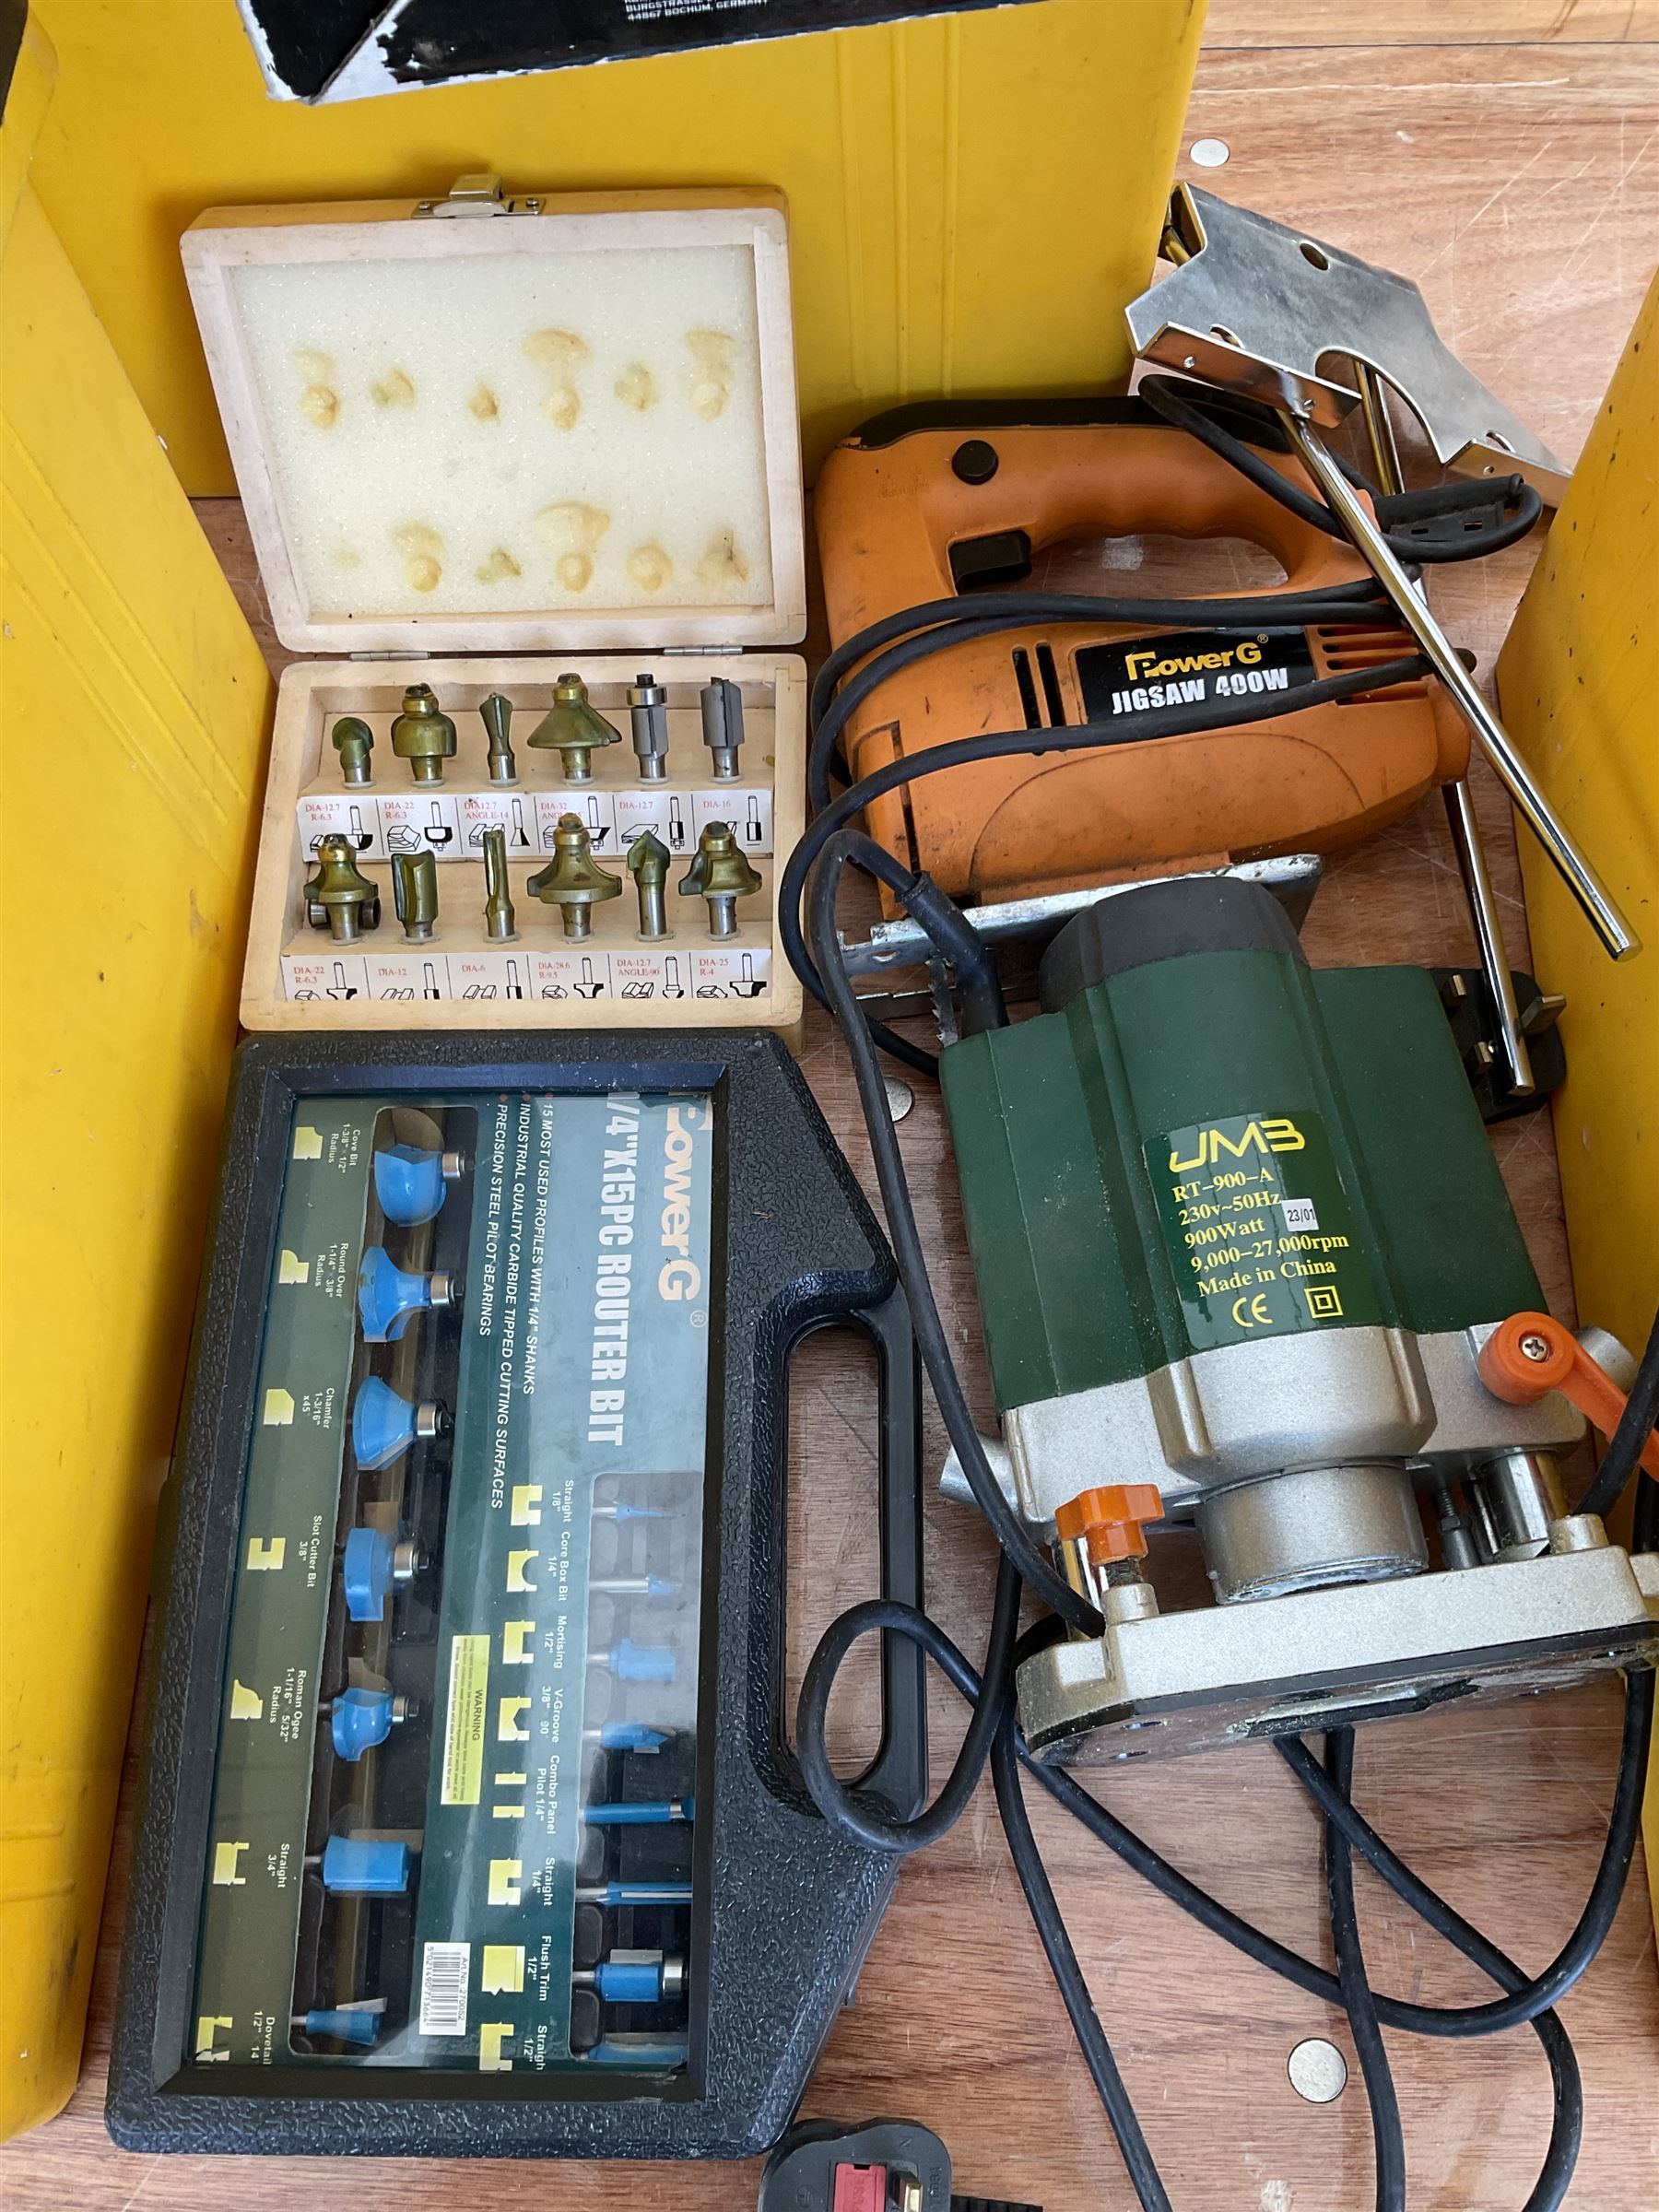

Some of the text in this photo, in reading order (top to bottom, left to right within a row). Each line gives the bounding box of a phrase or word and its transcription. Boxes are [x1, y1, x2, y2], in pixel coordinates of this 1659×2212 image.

[626, 0, 705, 12] BURGSTRAS
[1112, 667, 1288, 714] JIGSAW 400W
[384, 802, 414, 811] DIA-22
[294, 966, 325, 975] DIA-22
[379, 968, 407, 977] DIA-12
[462, 964, 486, 973] DIA-6
[700, 958, 729, 967] DIA-25
[328, 1133, 339, 1163] Radius
[348, 1129, 360, 1166] Cove Bit
[1170, 1119, 1305, 1173] JMB
[1172, 1167, 1274, 1203] RT-900-A
[478, 1104, 509, 1337] PRECISION STEEL PILOT BEARINGS
[1179, 1191, 1281, 1226] 230v~50Hz
[1288, 1208, 1315, 1222] 23/01
[523, 1103, 554, 1395] 15 MOST USED PROFILES WITH 1/4" SHANKS
[1184, 1218, 1266, 1250] 900Watt
[314, 1254, 326, 1287] Radius
[336, 1242, 348, 1298] Round Over
[1197, 1259, 1336, 1298] Made in China
[490, 1103, 532, 1510] INDUSTRIAL QUALITY CARBIDE TIPPED CUTTING SURFACES
[591, 1254, 632, 1381] ROUTER
[323, 1387, 335, 1430] Chamfer
[588, 1390, 625, 1446] BIT
[551, 1491, 562, 1512] 1/8"
[561, 1479, 574, 1523] Straight
[298, 1540, 309, 1560] 3/8"
[307, 1514, 323, 1587] Slot Cutter Bit
[547, 1556, 558, 1577] 1/4"
[558, 1531, 571, 1602] Core Box Bit
[544, 1631, 554, 1653] 1/2"
[554, 1616, 568, 1668] Mortising
[269, 1686, 281, 1723] Radius
[291, 1670, 307, 1740] Roman Ogee
[471, 1689, 484, 1742] WARNING
[541, 1686, 551, 1709] 3/8"
[551, 1688, 564, 1744] V-Groove
[535, 1768, 547, 1821] Pilot 1/4"
[547, 1754, 560, 1835] Combo Panel
[267, 1853, 277, 1877] 3/4"
[276, 1843, 290, 1888] Straight
[532, 1870, 542, 1893] 1/4"
[542, 1857, 555, 1906] Straight
[527, 1956, 537, 1981] 1/2"
[538, 1936, 551, 2001] Flush Trim
[253, 2010, 264, 2033] 1/2"
[263, 2017, 276, 2065] Dovetail
[524, 2038, 534, 2063] 1/2"
